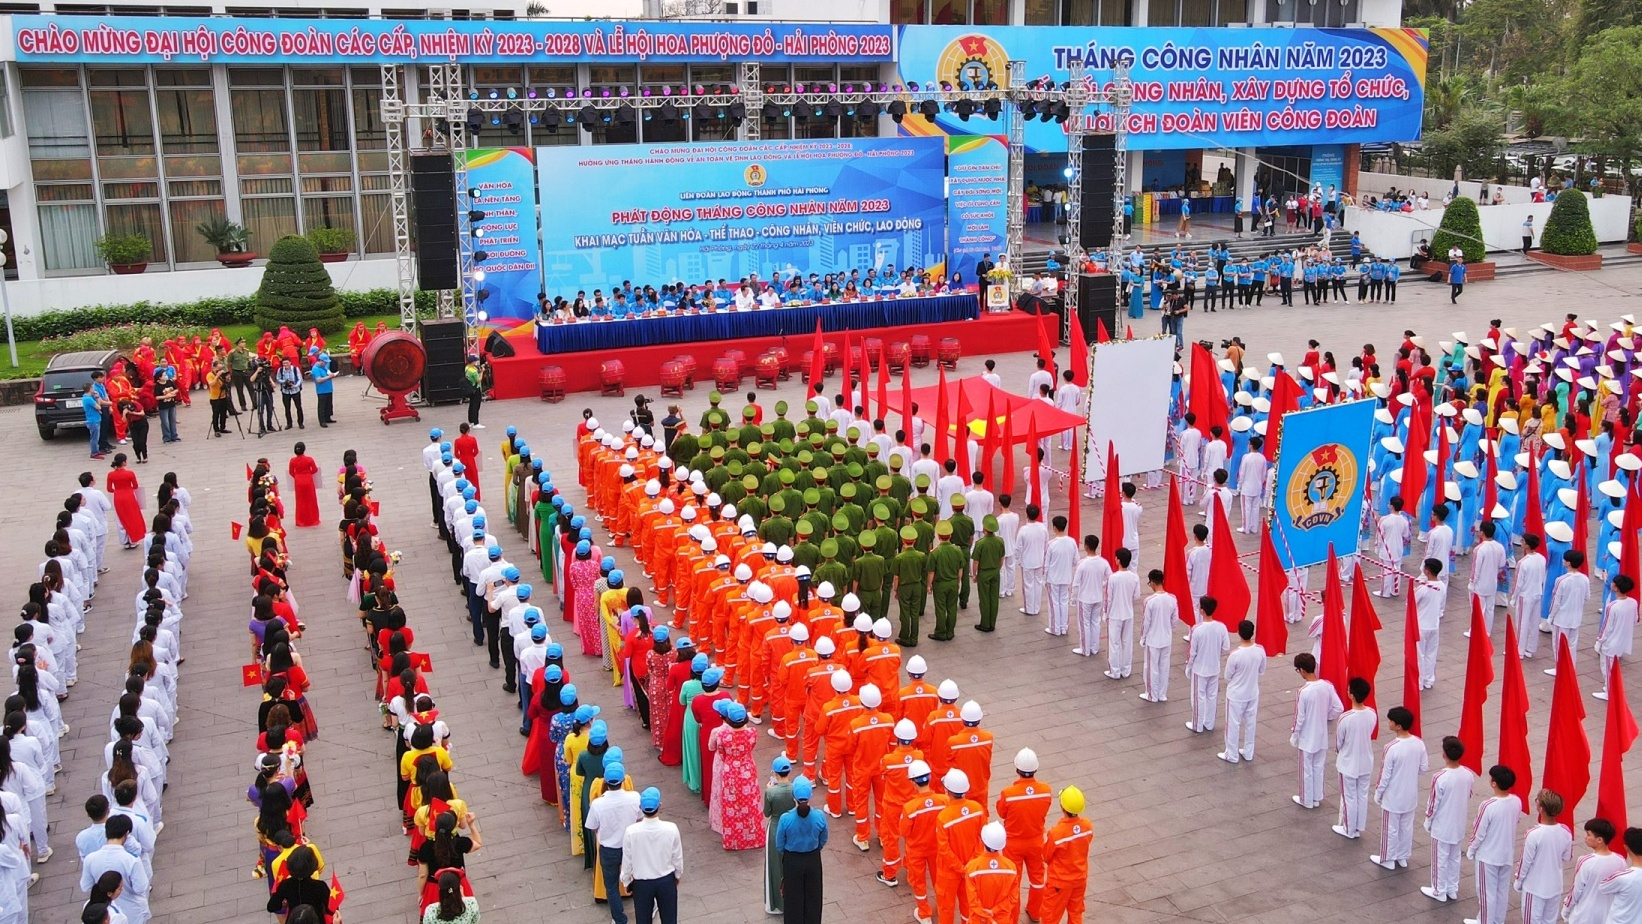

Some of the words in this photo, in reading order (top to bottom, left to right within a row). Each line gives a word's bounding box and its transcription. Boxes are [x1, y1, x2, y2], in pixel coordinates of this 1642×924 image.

[18, 22, 78, 54] CHÀO
[82, 23, 141, 54] MỪNG
[145, 30, 178, 60] ĐẠI
[182, 26, 217, 60] HỘI
[220, 26, 277, 54] CÔNG
[280, 26, 332, 55] ĐOÀN
[335, 25, 375, 56] CÁC
[378, 24, 417, 59] CẤP,
[419, 28, 470, 61] NHIỆM
[473, 30, 495, 56] KỲ
[497, 33, 533, 56] 2023
[545, 33, 580, 56] 2028
[584, 28, 607, 55] VÀ
[608, 25, 624, 56] LỄ
[626, 28, 653, 61] HỘI
[656, 33, 687, 56] HOA
[690, 32, 750, 61] PHƯỢNG
[752, 28, 774, 56] ĐỎ
[784, 28, 807, 56] HẢI
[810, 30, 857, 56] PHÒNG
[859, 34, 890, 56] 2023
[1053, 40, 1136, 70] THÁNG
[1142, 41, 1212, 70] CÔNG
[1217, 41, 1281, 70] NHÂN
[1284, 41, 1334, 70] NĂM
[1338, 45, 1388, 69] 2023
[1167, 76, 1226, 103] NHÂN,
[1231, 76, 1270, 100] XÂY
[1274, 78, 1325, 104] DỰNG
[1329, 70, 1352, 99] TỔ
[1355, 74, 1410, 99] CHỨC,
[1161, 108, 1218, 133] ĐOÀN
[1221, 107, 1264, 131] VIÊN
[1266, 106, 1321, 130] CÔNG
[1326, 103, 1377, 128] ĐOÀN
[611, 208, 648, 224] PHÁT
[650, 206, 693, 224] ĐỘNG
[696, 204, 742, 220] THÁNG
[746, 202, 786, 218] CÔNG
[789, 200, 826, 216] NHÂN
[828, 199, 858, 214] NĂM
[860, 200, 890, 212] 2023
[574, 235, 600, 248] KHAI
[602, 234, 626, 248] MẠC
[628, 227, 654, 245] TUẦN
[656, 230, 678, 244] VĂN
[680, 229, 702, 242] HÓA
[709, 223, 726, 240] THỂ
[728, 228, 753, 240] THAO
[761, 223, 790, 238] CÔNG
[792, 222, 822, 236] NHÂN,
[824, 220, 843, 234] VIÊN
[845, 219, 874, 233] CHỨC,
[876, 220, 894, 231] LAO
[894, 218, 922, 232] ĐỘNG
